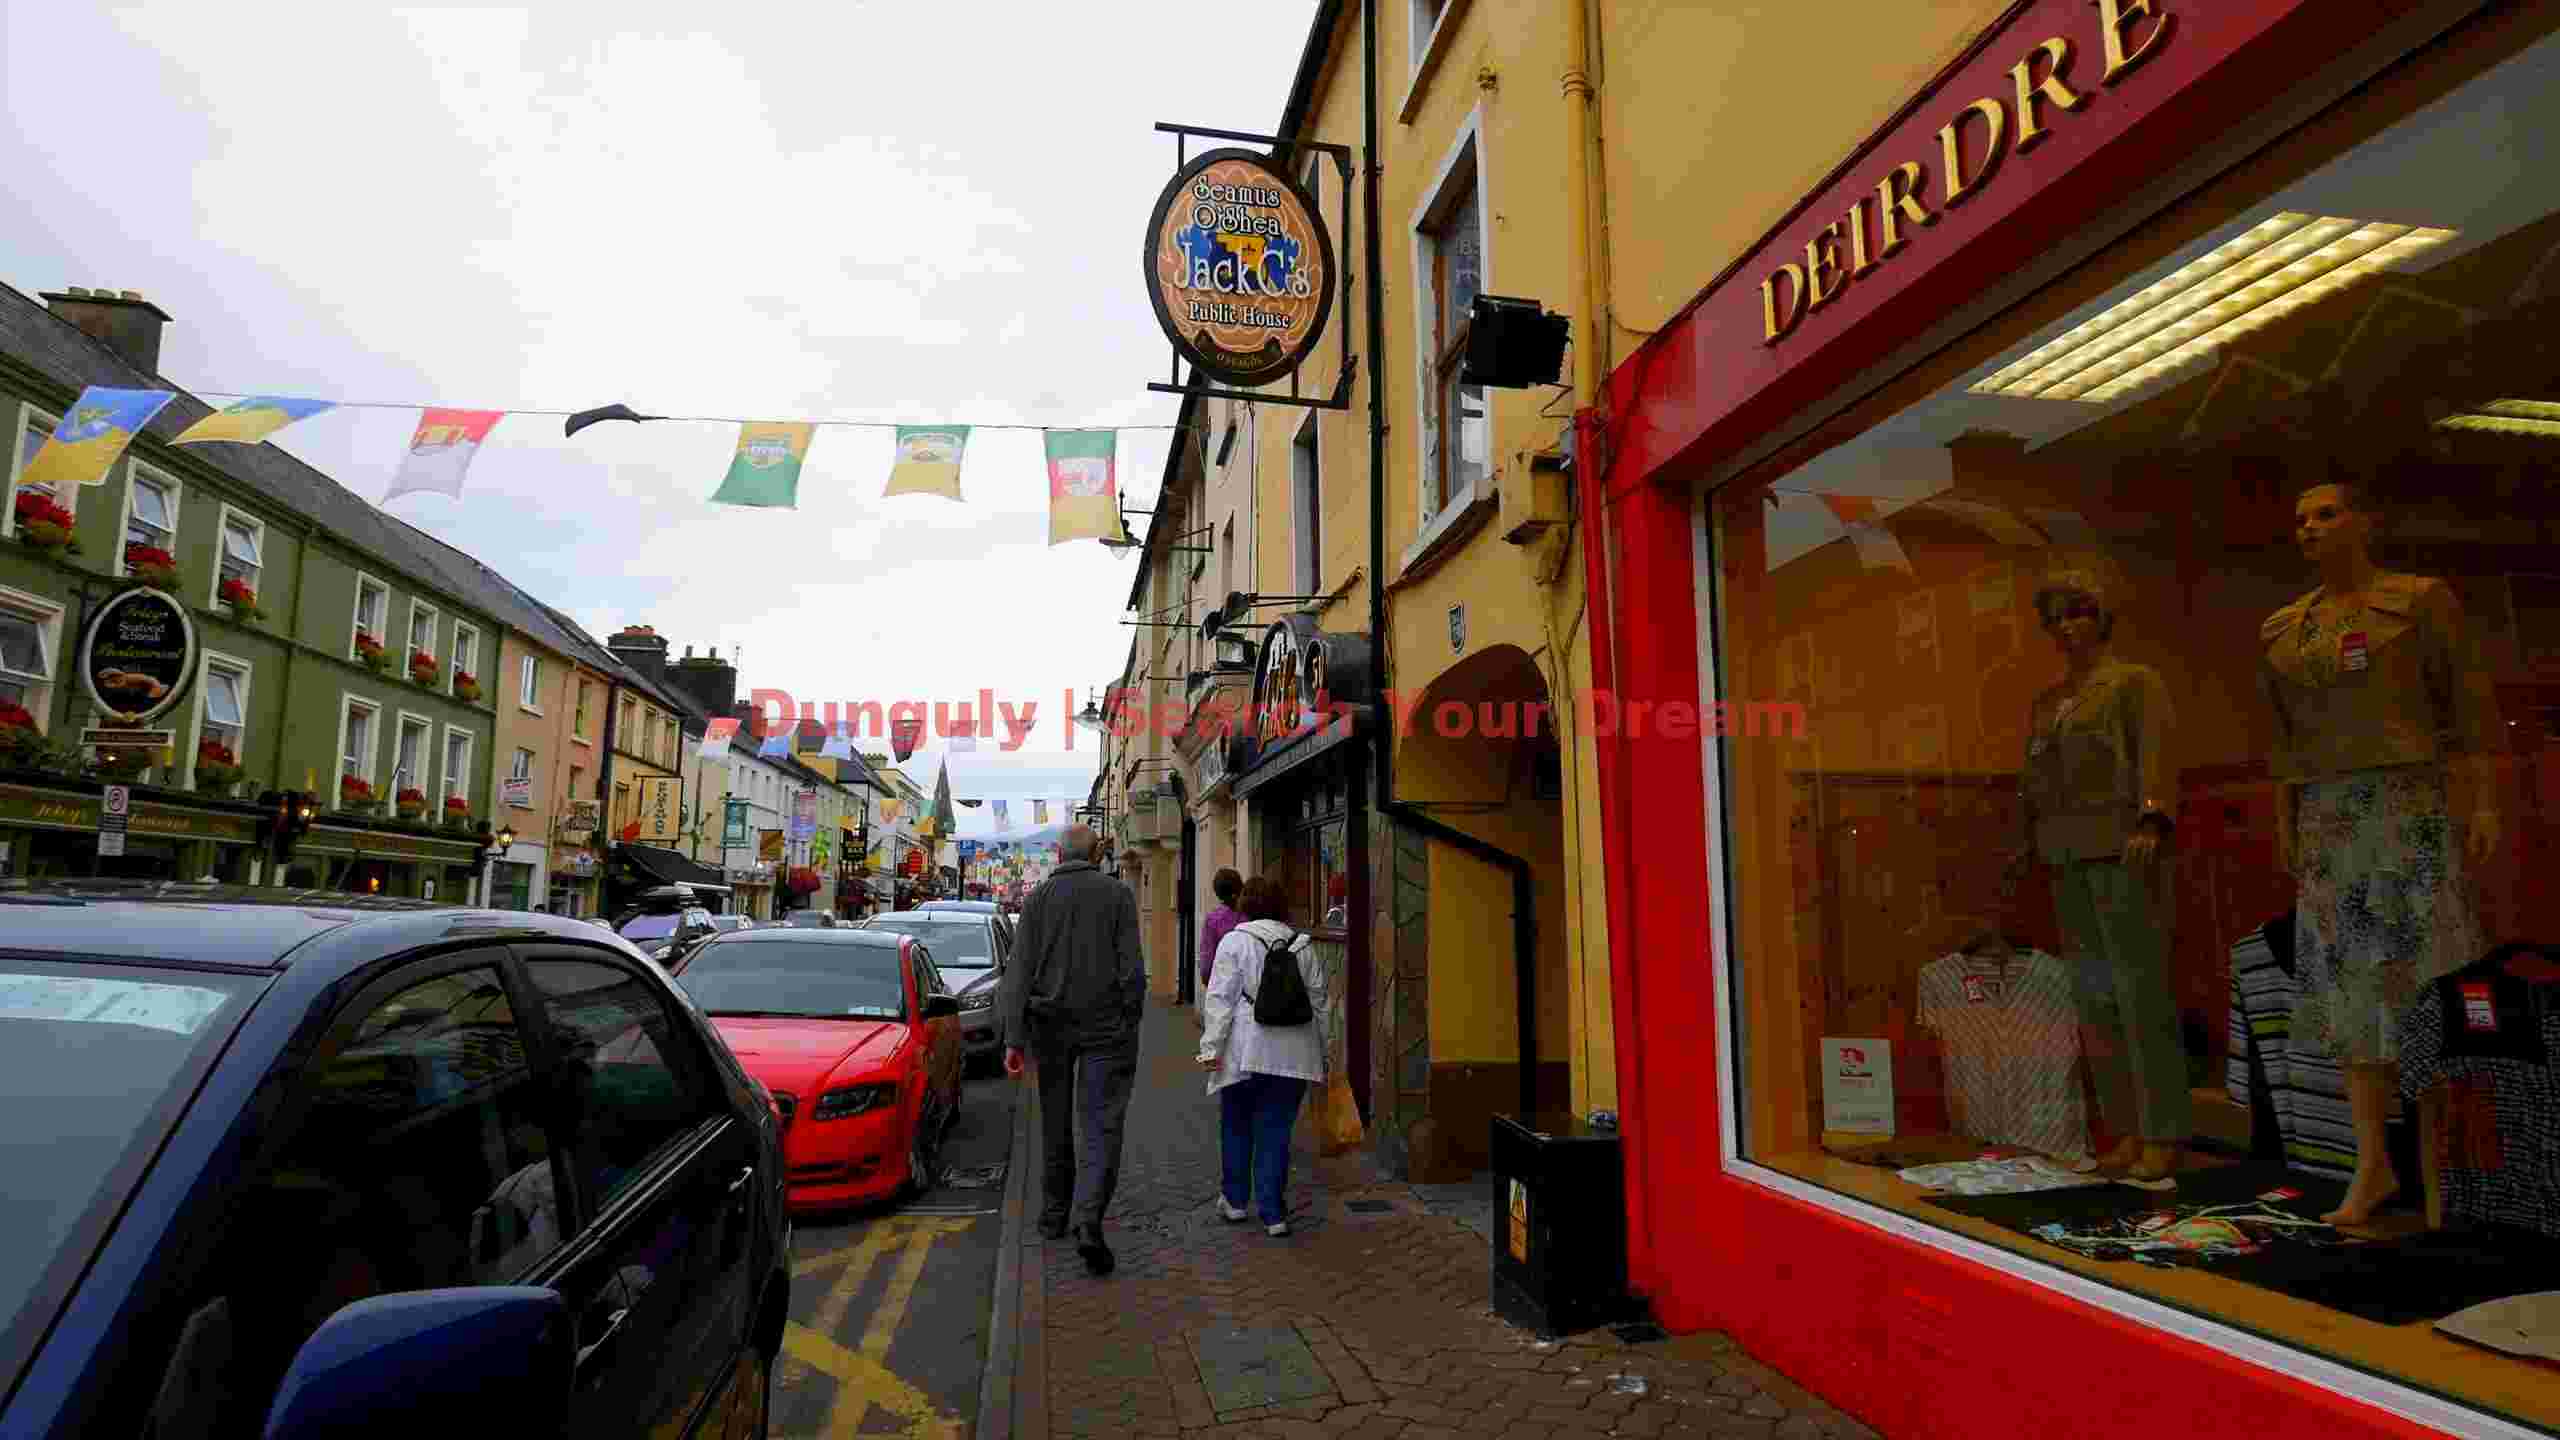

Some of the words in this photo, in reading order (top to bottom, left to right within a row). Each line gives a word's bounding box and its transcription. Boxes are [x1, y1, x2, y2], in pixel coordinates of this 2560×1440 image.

[1759, 0, 2169, 343] DEIRDRE
[1192, 176, 1281, 208] Seamus
[1187, 301, 1236, 324] Public
[1240, 306, 1291, 329] House
